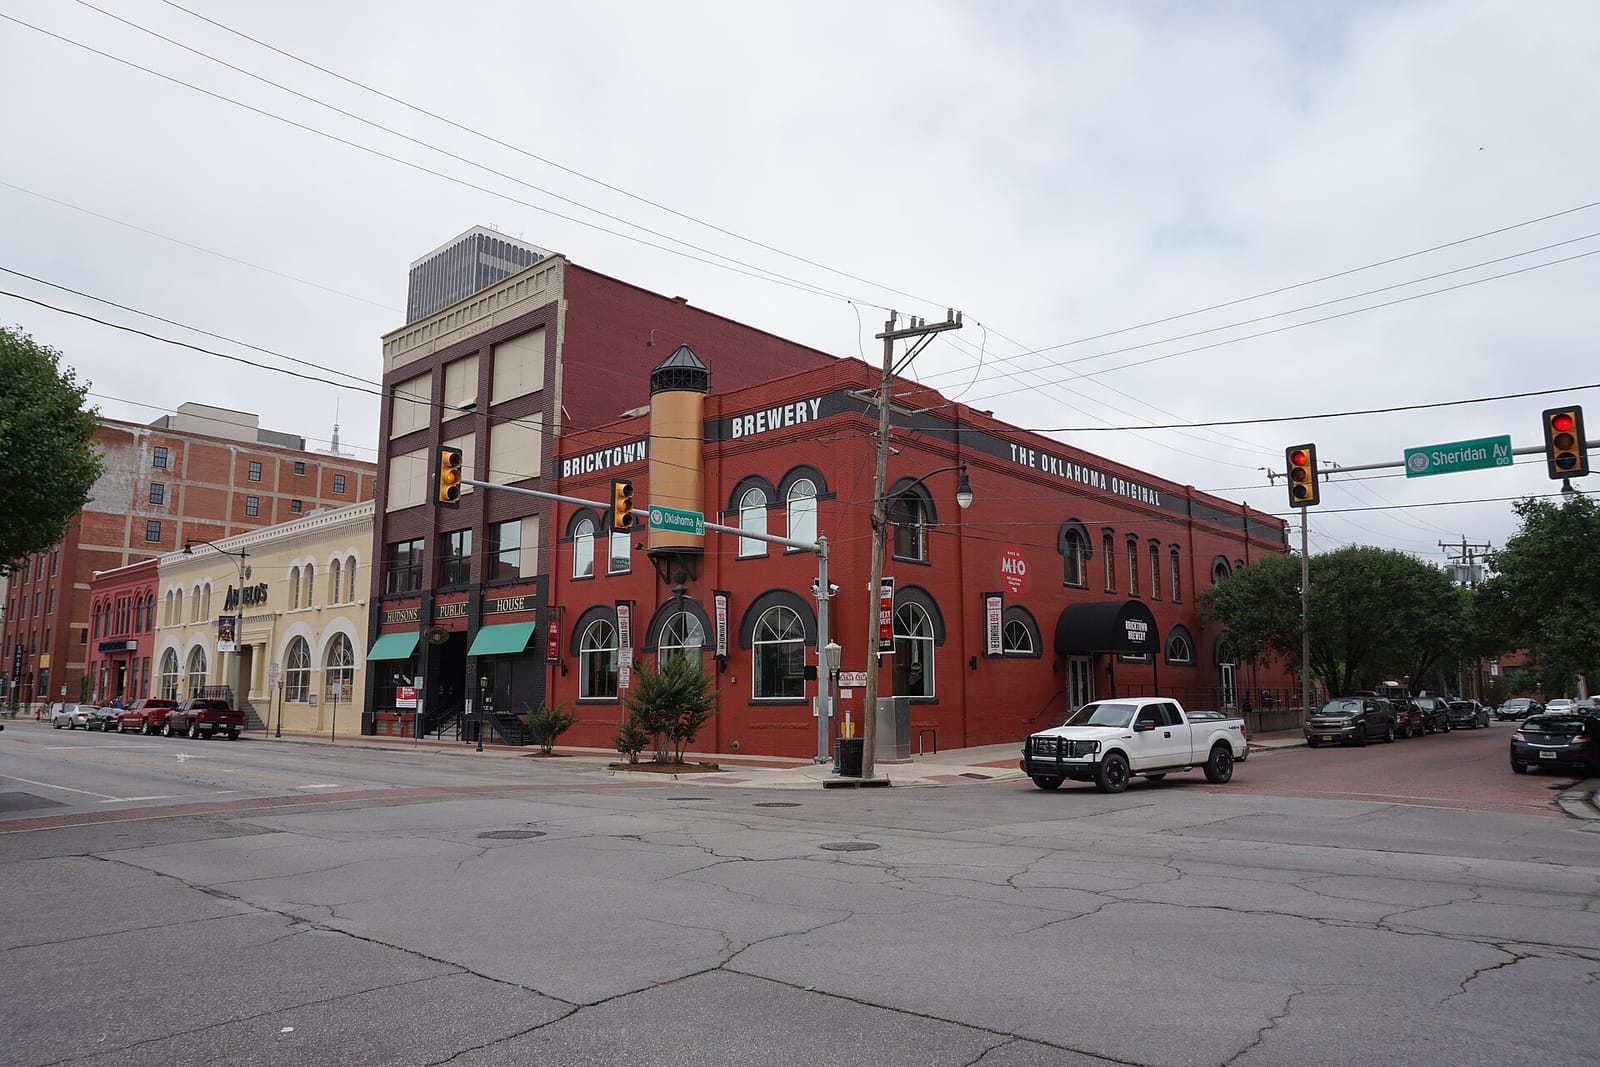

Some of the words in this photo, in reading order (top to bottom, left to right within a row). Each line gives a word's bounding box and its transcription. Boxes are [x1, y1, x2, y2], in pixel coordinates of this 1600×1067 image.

[732, 397, 822, 439] BREWERY
[563, 441, 646, 478] BRICKTOWN
[1432, 447, 1487, 466] Sheridan
[1493, 443, 1508, 458] Av
[1010, 443, 1036, 468] THE
[1041, 454, 1107, 490] OKLAHOMA
[1112, 477, 1161, 507] ORIGINAL
[664, 512, 694, 527] Oklahoma
[387, 608, 418, 623] HUDSONS
[439, 603, 466, 617] PUBLIC
[496, 597, 525, 612] HOUSE
